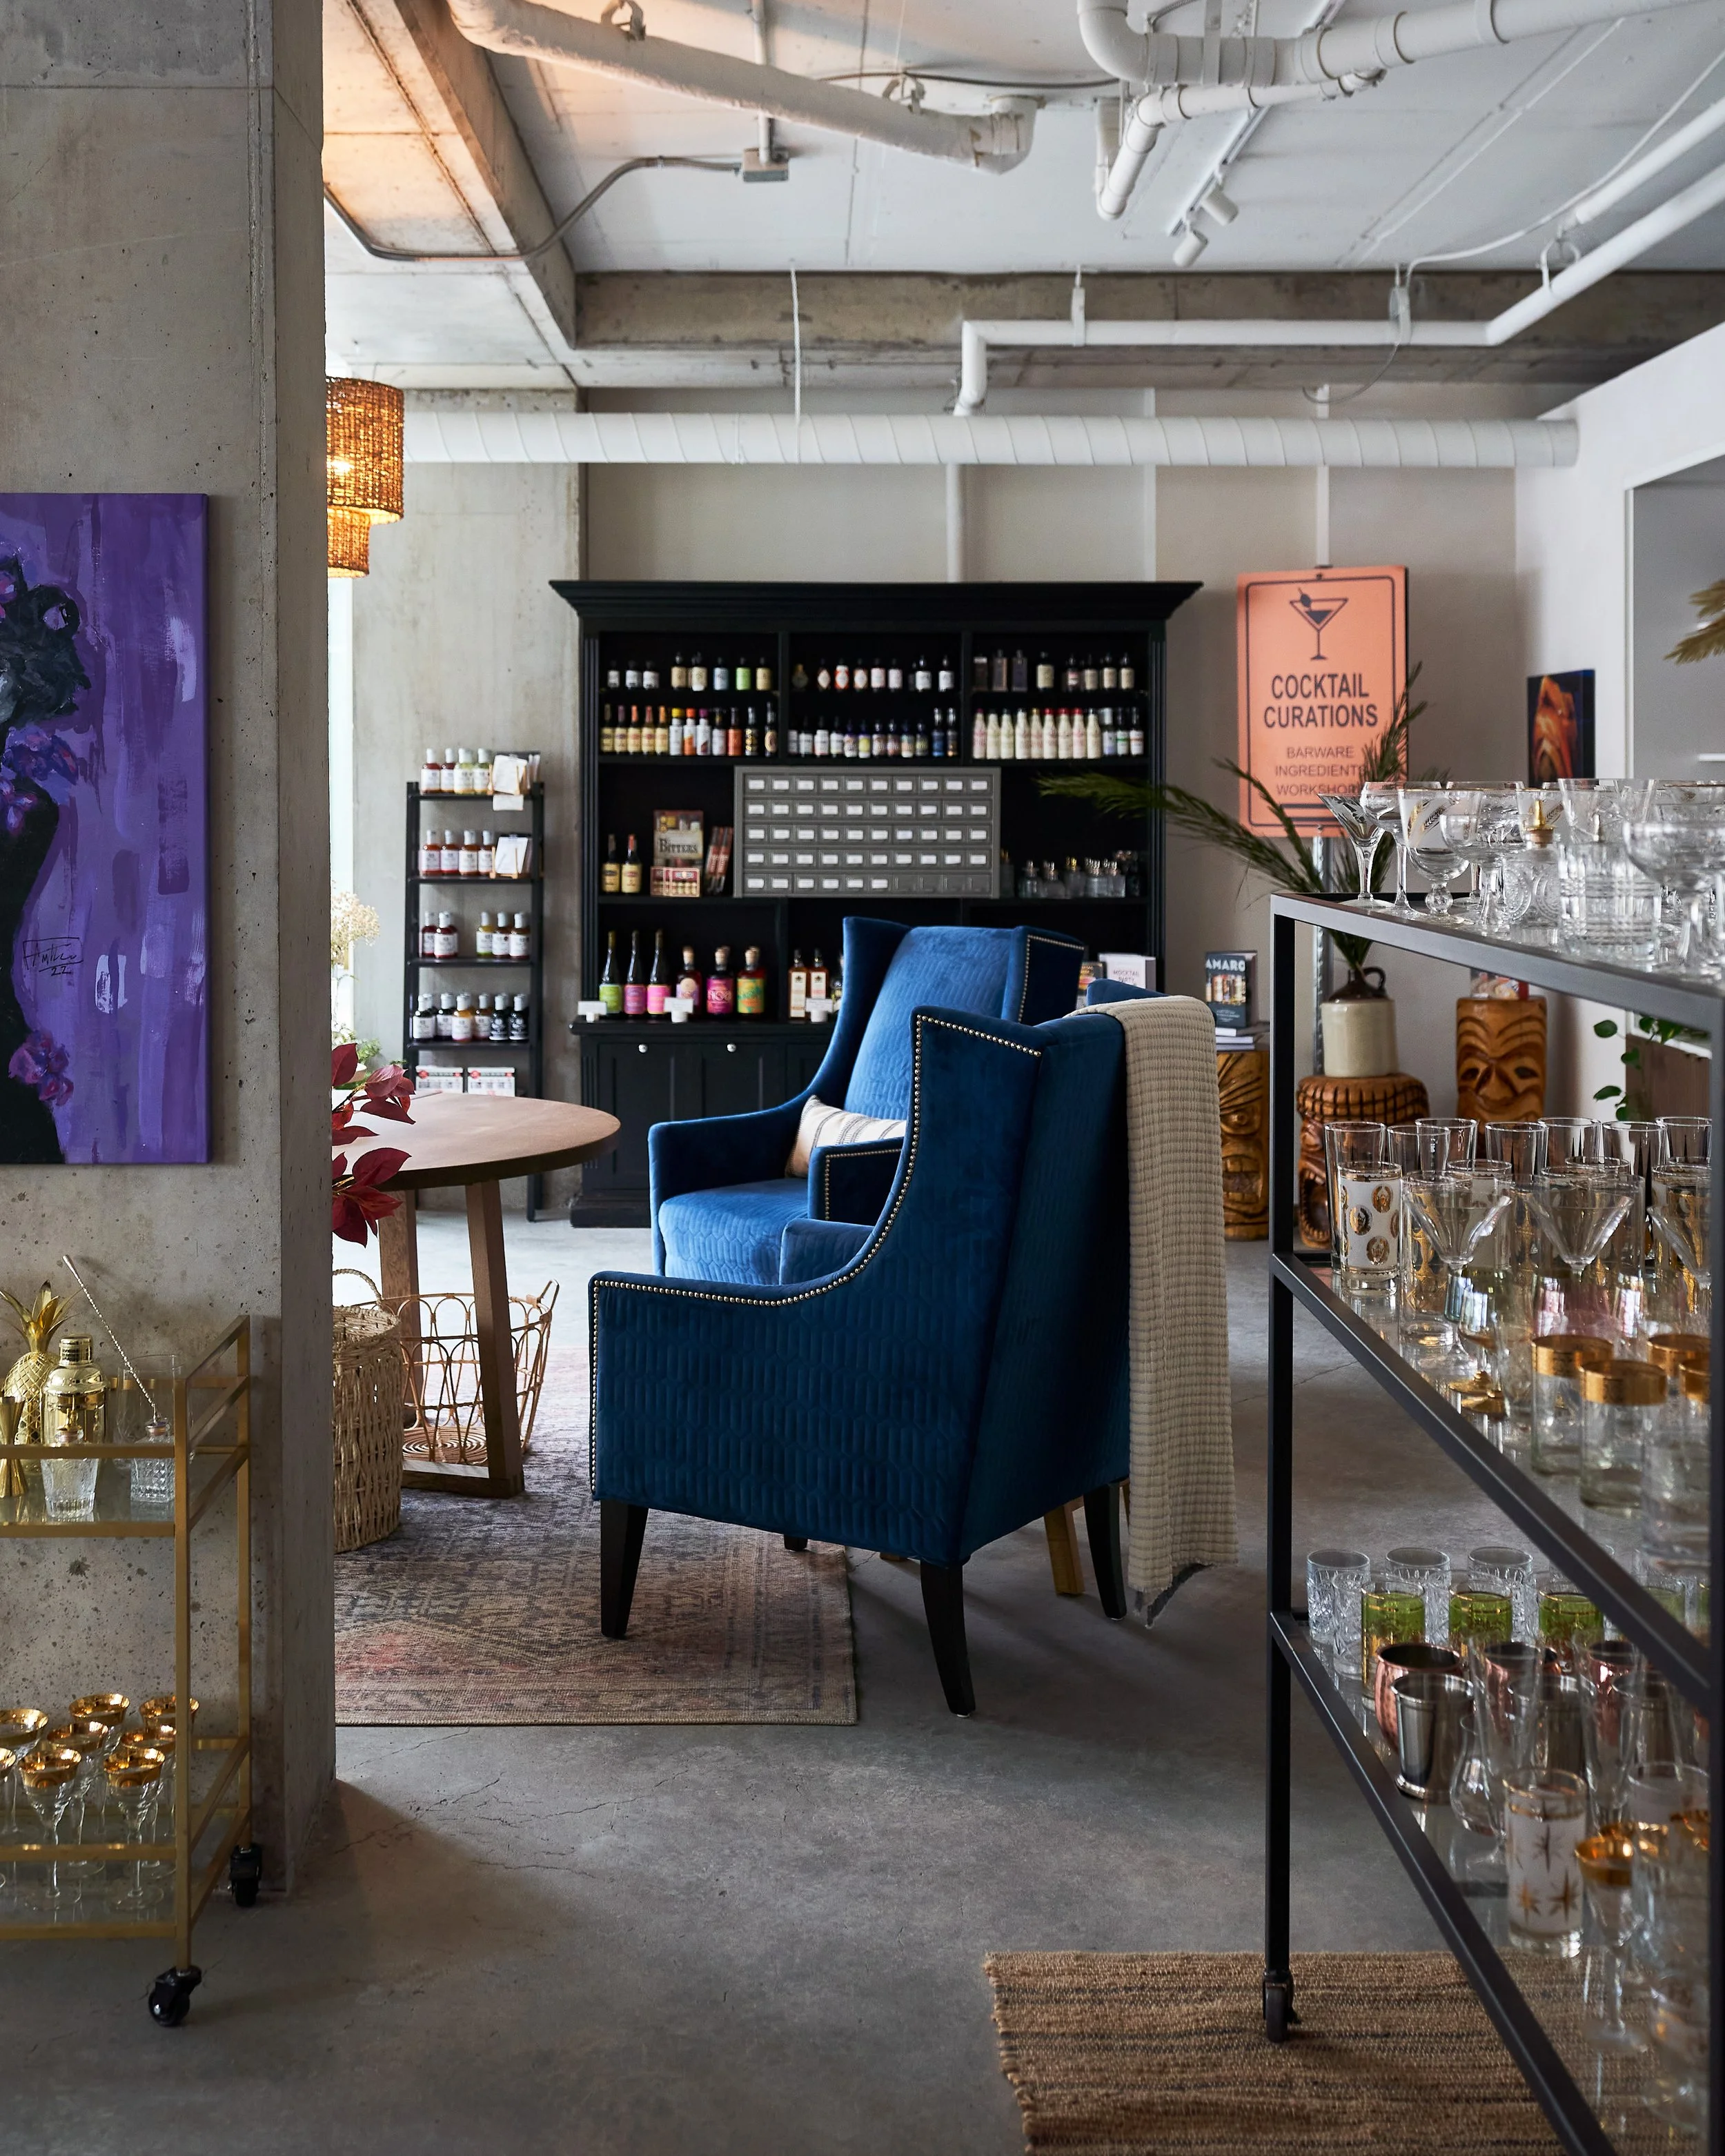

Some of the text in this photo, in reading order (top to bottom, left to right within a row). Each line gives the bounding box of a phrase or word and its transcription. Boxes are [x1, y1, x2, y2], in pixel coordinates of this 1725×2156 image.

[1271, 672, 1370, 700] COCKTAIL
[1263, 703, 1379, 729] CURATIONS
[1287, 746, 1354, 759] BARWARE
[1276, 783, 1363, 795] WORKSHOP
[51, 965, 72, 976] 22
[1205, 958, 1245, 971] AMARO
